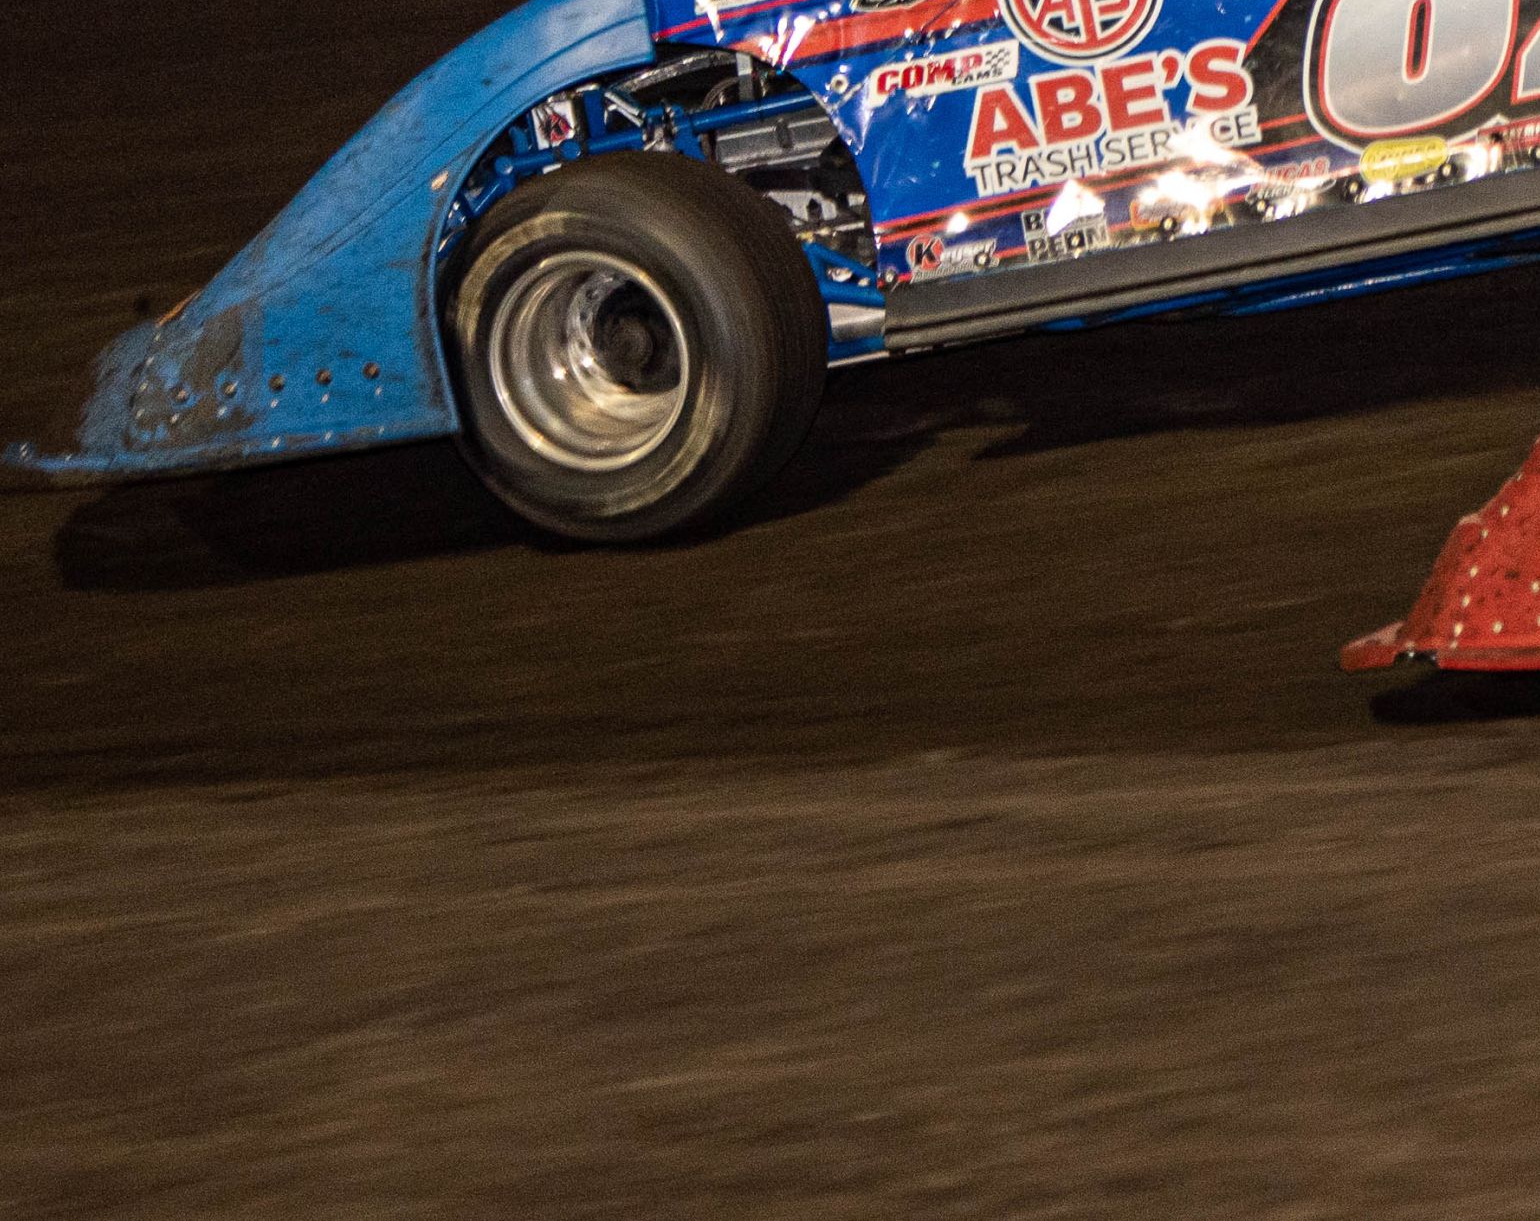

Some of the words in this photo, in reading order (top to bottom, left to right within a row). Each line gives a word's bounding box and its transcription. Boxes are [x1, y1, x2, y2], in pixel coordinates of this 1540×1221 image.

[876, 52, 984, 96] COMP
[970, 44, 1248, 159] ABE'S
[973, 144, 1094, 191] TRASH
[1104, 111, 1257, 167] SERCE
